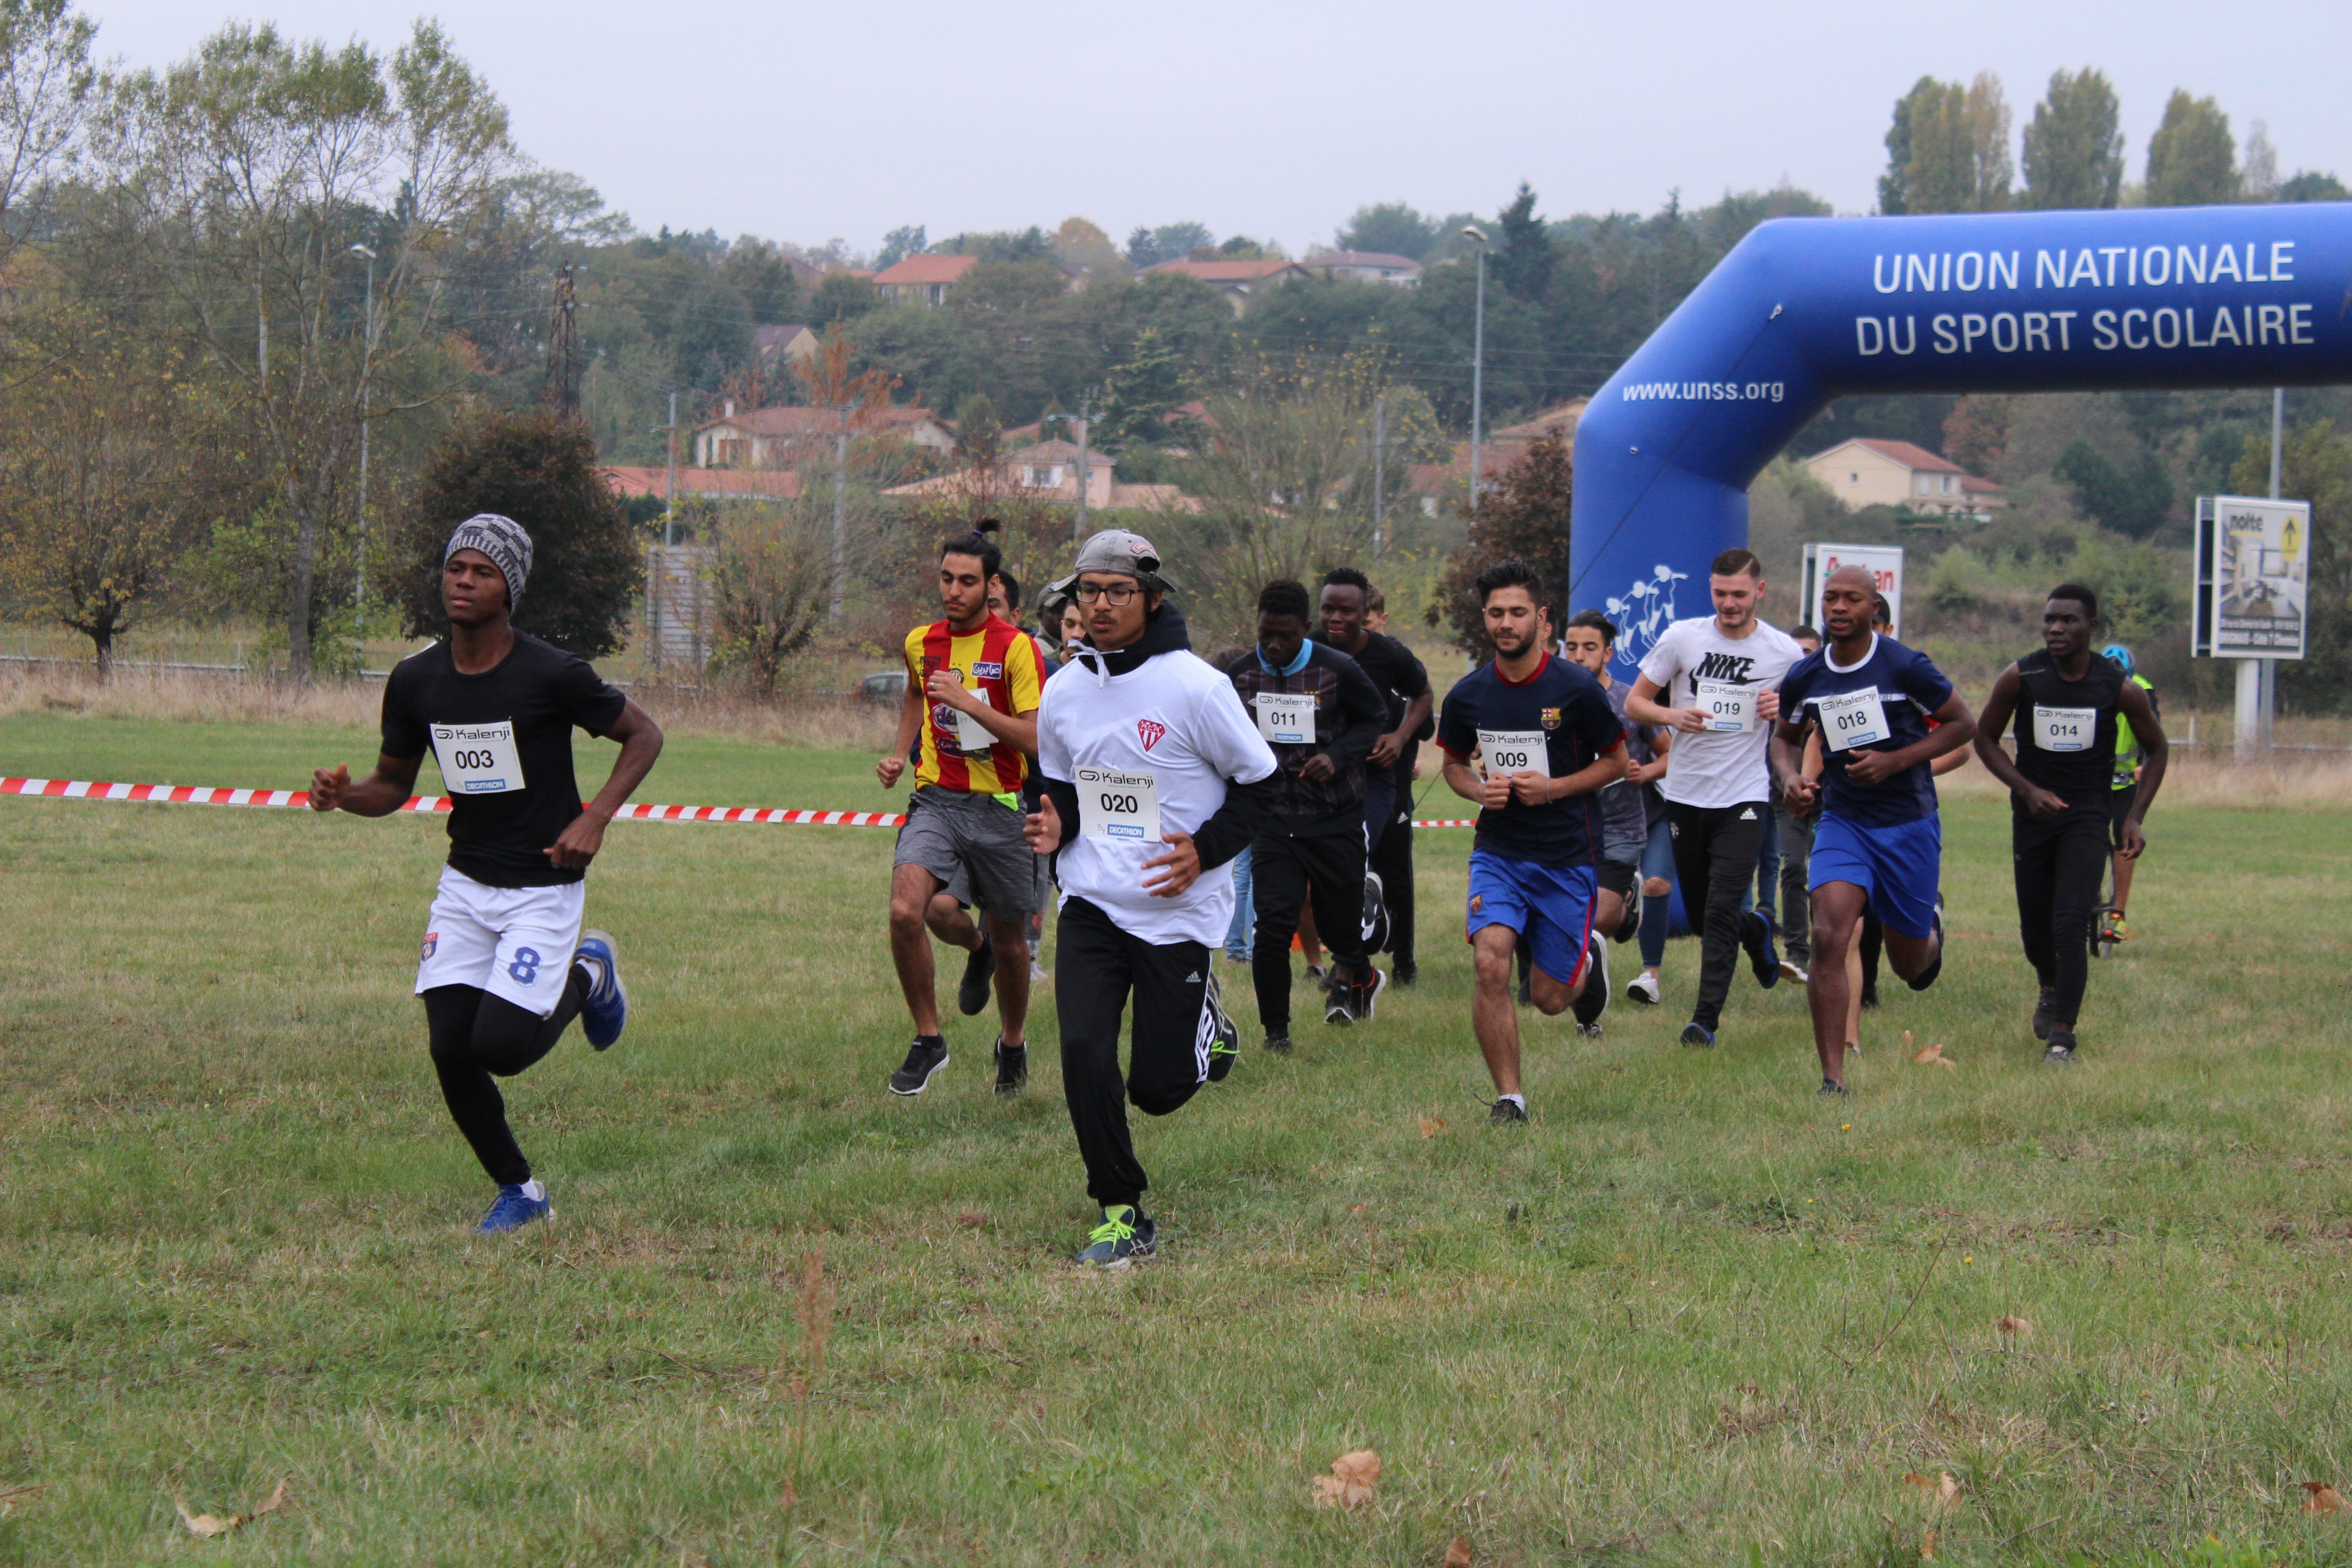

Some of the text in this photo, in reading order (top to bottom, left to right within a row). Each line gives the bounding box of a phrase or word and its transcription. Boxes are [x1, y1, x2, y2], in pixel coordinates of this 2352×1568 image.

[1874, 242, 2295, 294] UNION NATIONALE
[1856, 304, 2314, 355] DU SPORT SCOLAIRE
[1623, 382, 1784, 402] www.unss.org
[2230, 512, 2263, 531] nolte
[1695, 652, 1755, 681] NIKE
[1719, 687, 1756, 699] Kalenji
[1836, 691, 1877, 708] Kalenji
[1275, 697, 1312, 709] Kalenji
[1713, 701, 1740, 715] 019
[1271, 712, 1295, 726] 011
[1838, 711, 1867, 730] 018
[2055, 711, 2093, 721] Kalenji
[456, 726, 510, 741] Kalenji
[2050, 724, 2078, 736] 014
[1498, 735, 1543, 745] Kalenji
[455, 750, 494, 769] 003
[1495, 752, 1527, 767] 009
[466, 781, 503, 790] DECATHLON
[1102, 772, 1153, 789] Kalenji
[1101, 793, 1138, 813] 020
[1097, 824, 1142, 836] By DECATHLON
[509, 946, 541, 985] 8
